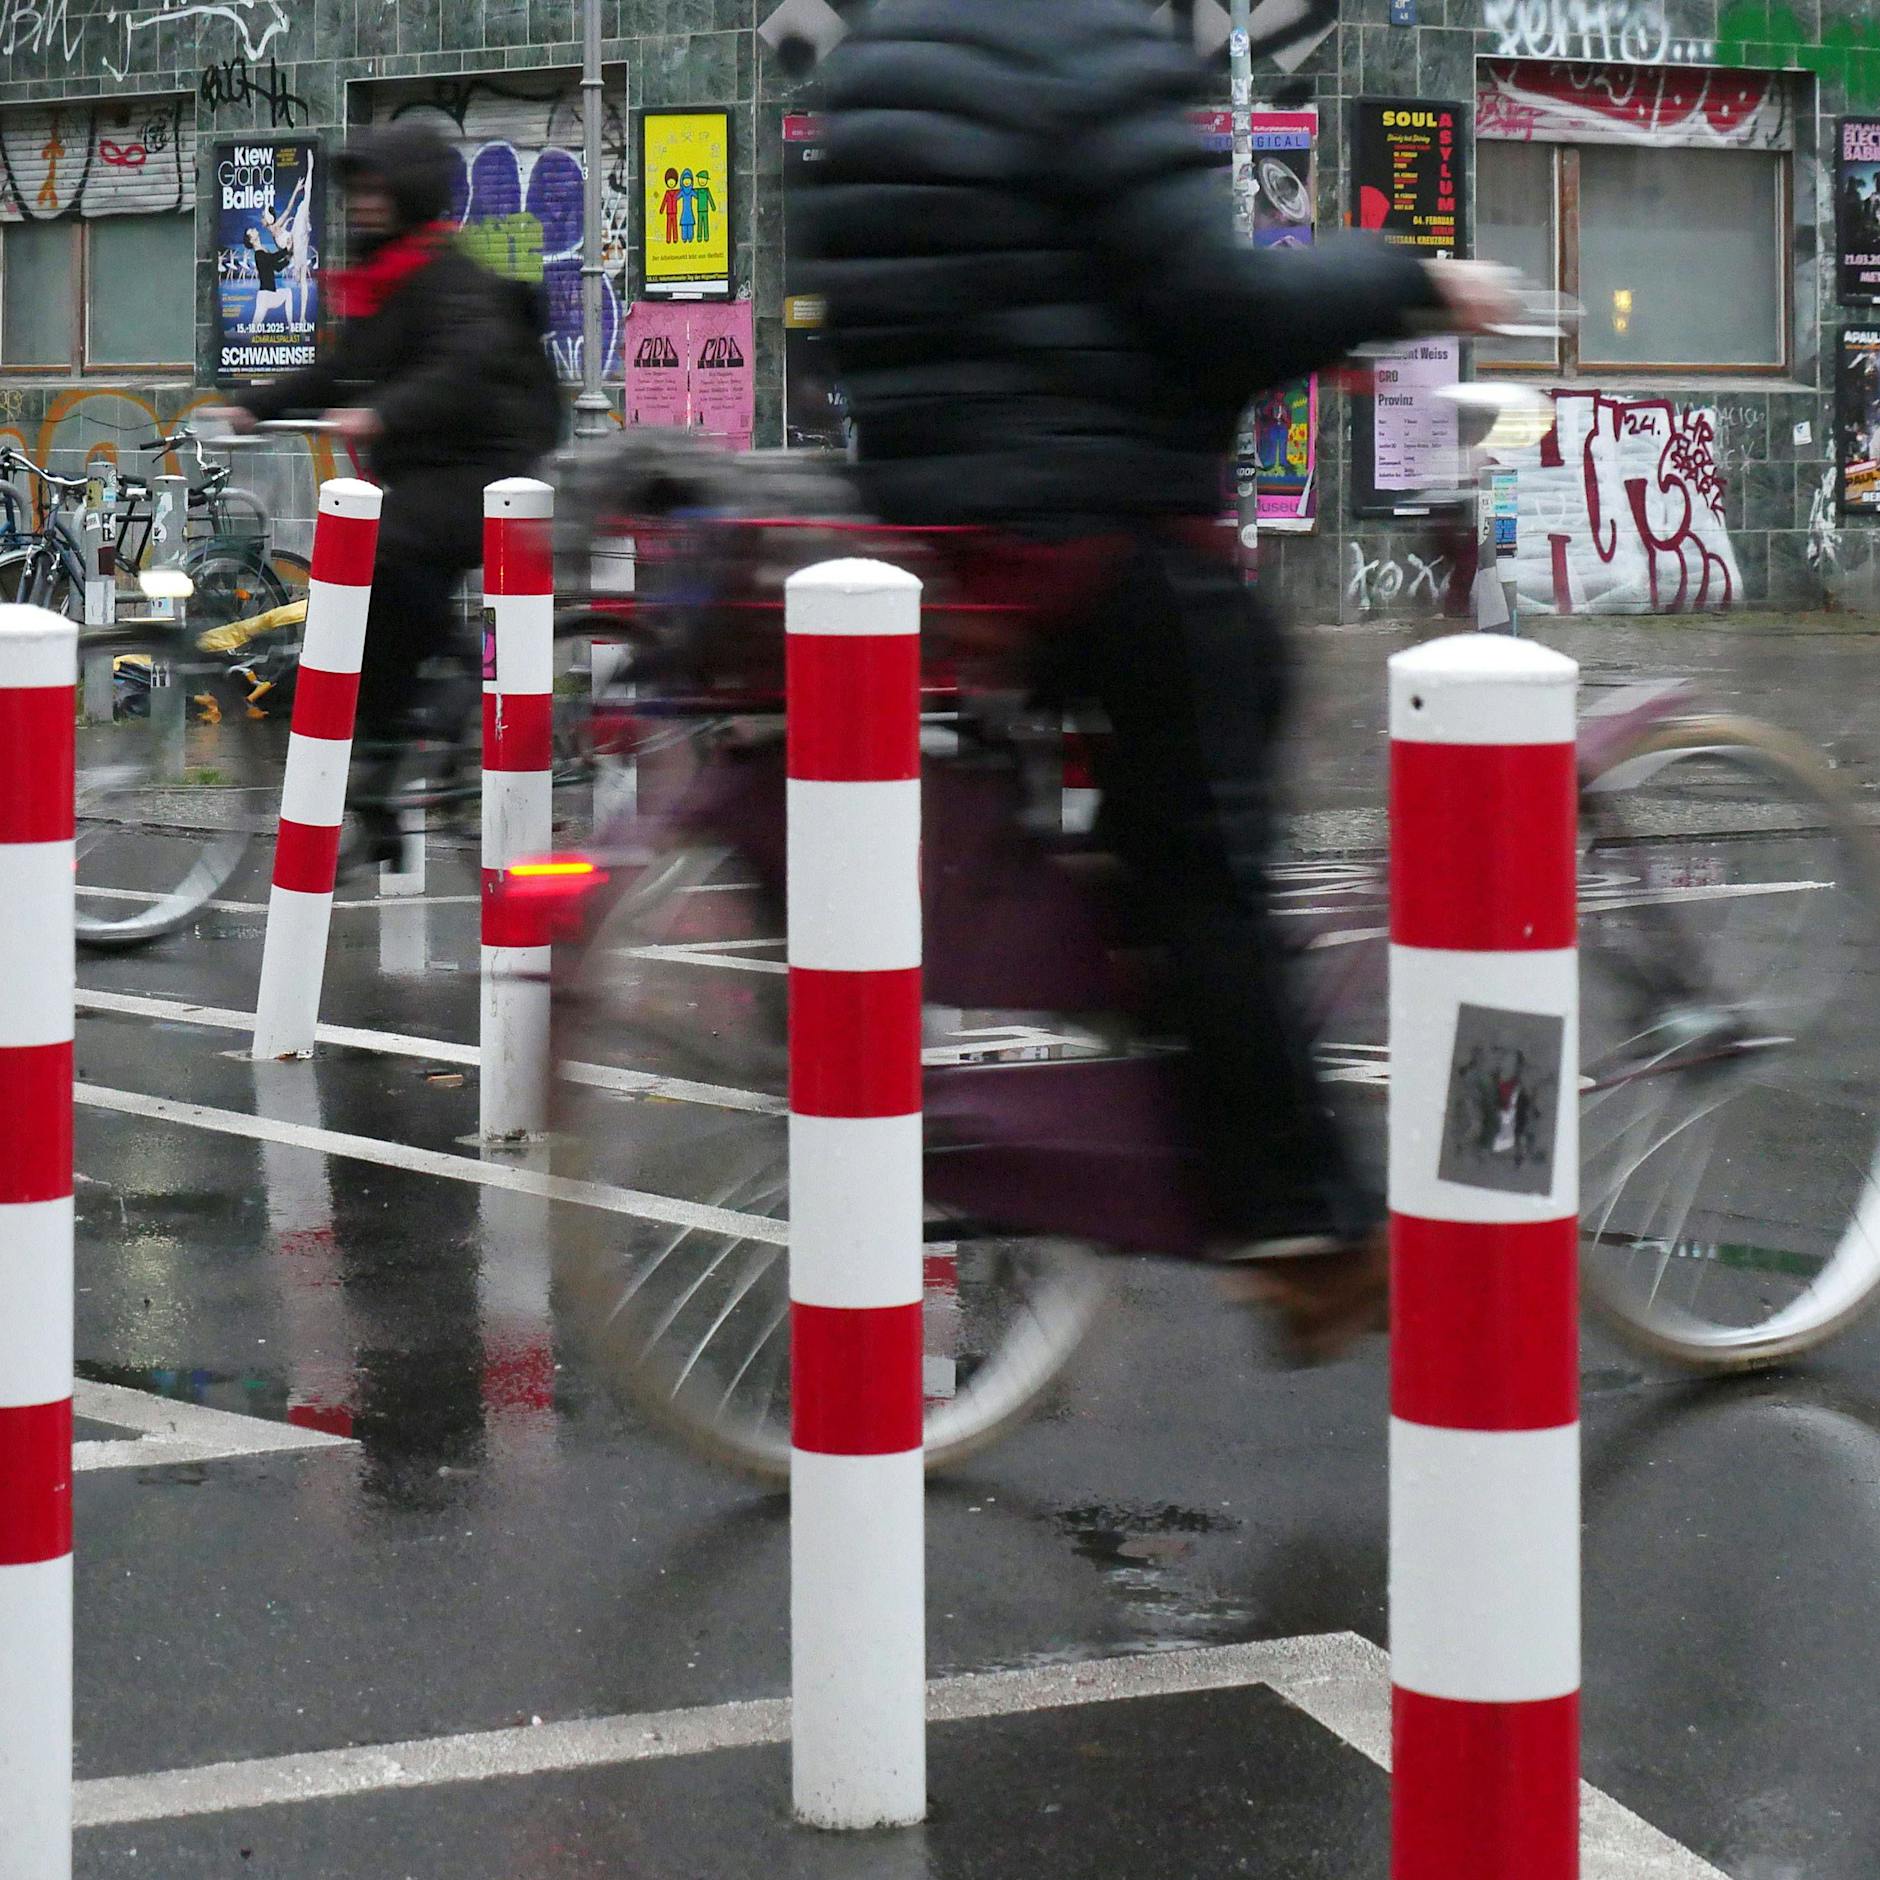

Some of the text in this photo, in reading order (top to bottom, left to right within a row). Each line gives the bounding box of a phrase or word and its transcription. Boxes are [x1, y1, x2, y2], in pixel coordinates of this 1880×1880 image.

[1382, 111, 1437, 127] SOUL
[234, 146, 273, 166] Kiew
[1438, 113, 1455, 211] ASYLUM
[218, 160, 274, 187] Grand
[222, 184, 275, 209] Ballett
[1426, 216, 1454, 225] FEBRUAR
[1417, 236, 1454, 245] KREUZBERG
[290, 322, 315, 332] BERLIN
[221, 346, 315, 366] SCHWANENSEE
[1420, 347, 1449, 360] Weiss
[1378, 393, 1414, 406] Provinz
[1624, 412, 1661, 436] 24.
